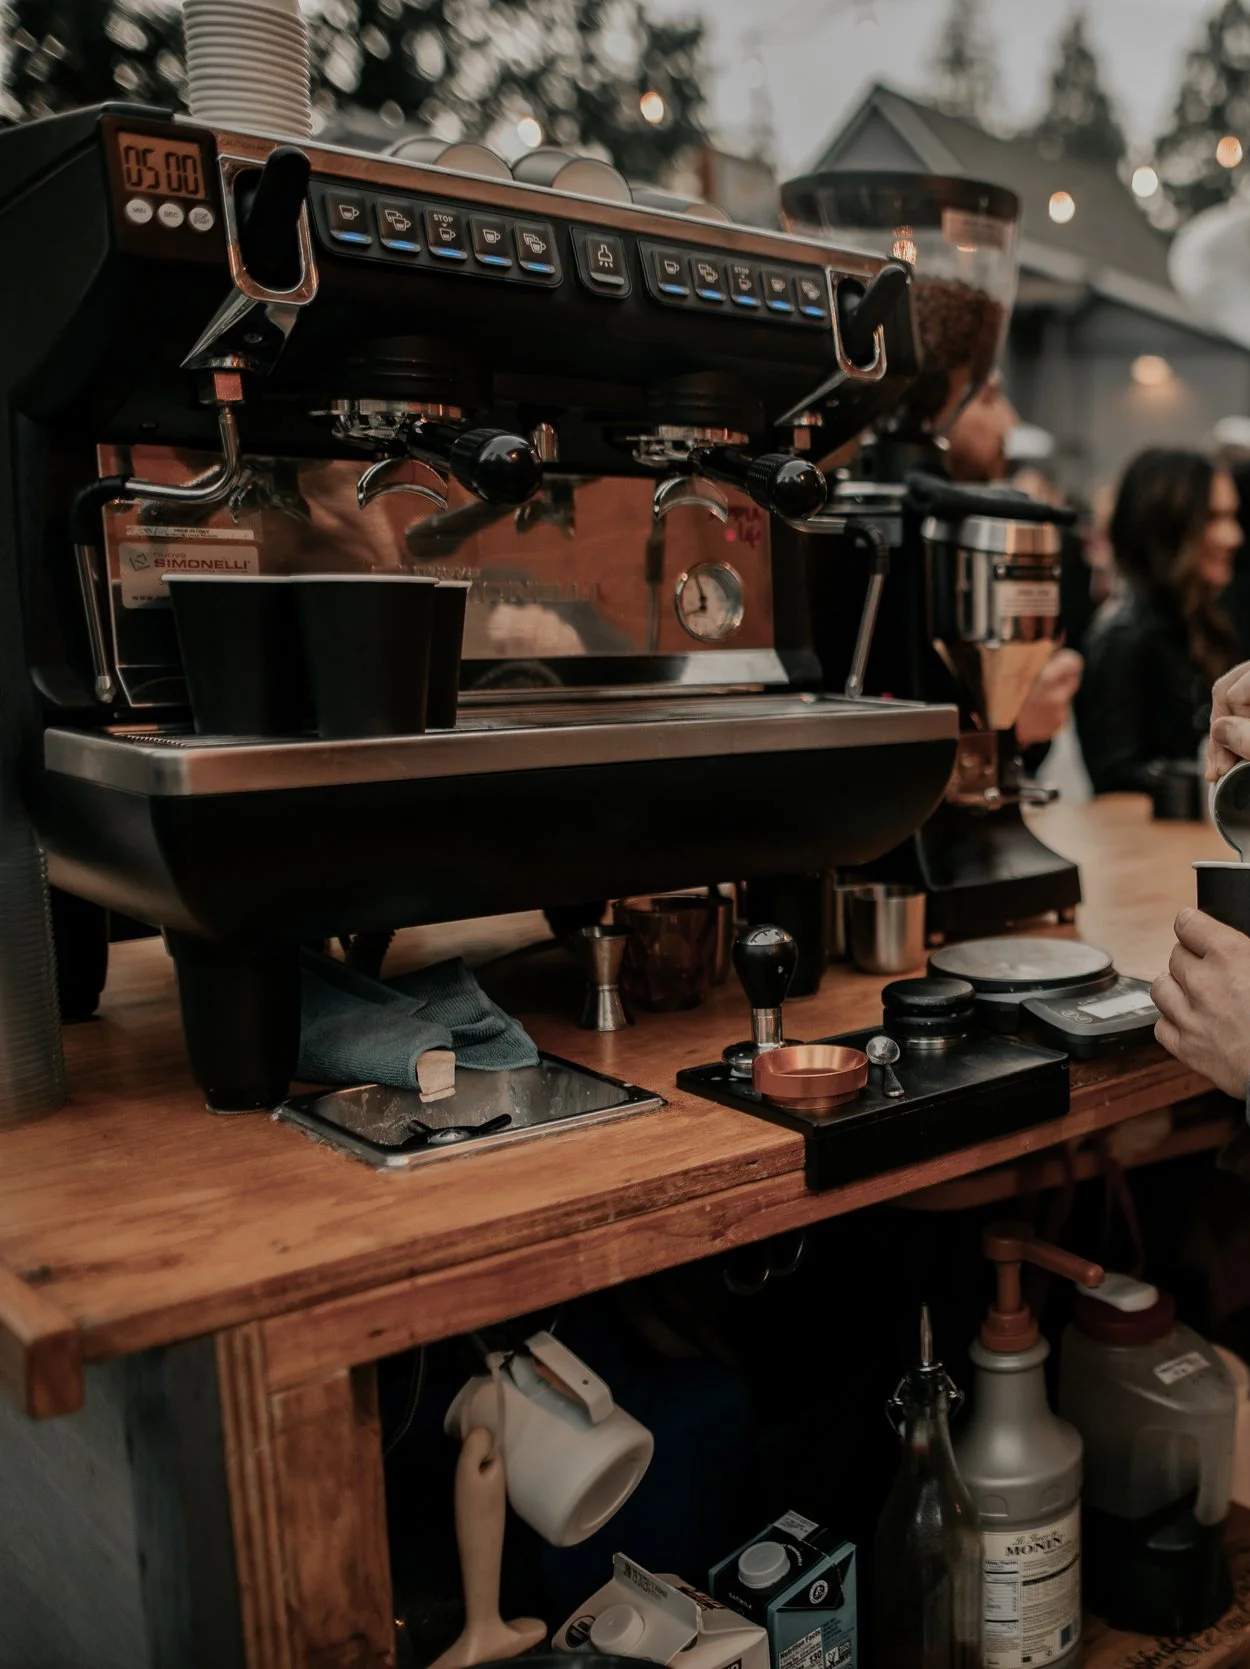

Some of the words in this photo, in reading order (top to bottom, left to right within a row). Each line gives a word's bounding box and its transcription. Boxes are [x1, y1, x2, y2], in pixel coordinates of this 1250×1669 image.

[433, 213, 454, 223] STOP
[734, 266, 750, 275] STOP
[154, 558, 248, 570] SIMONELLI
[1005, 1536, 1063, 1556] MONIN
[780, 1640, 805, 1659] Nutrition
[805, 1629, 821, 1643] Facts
